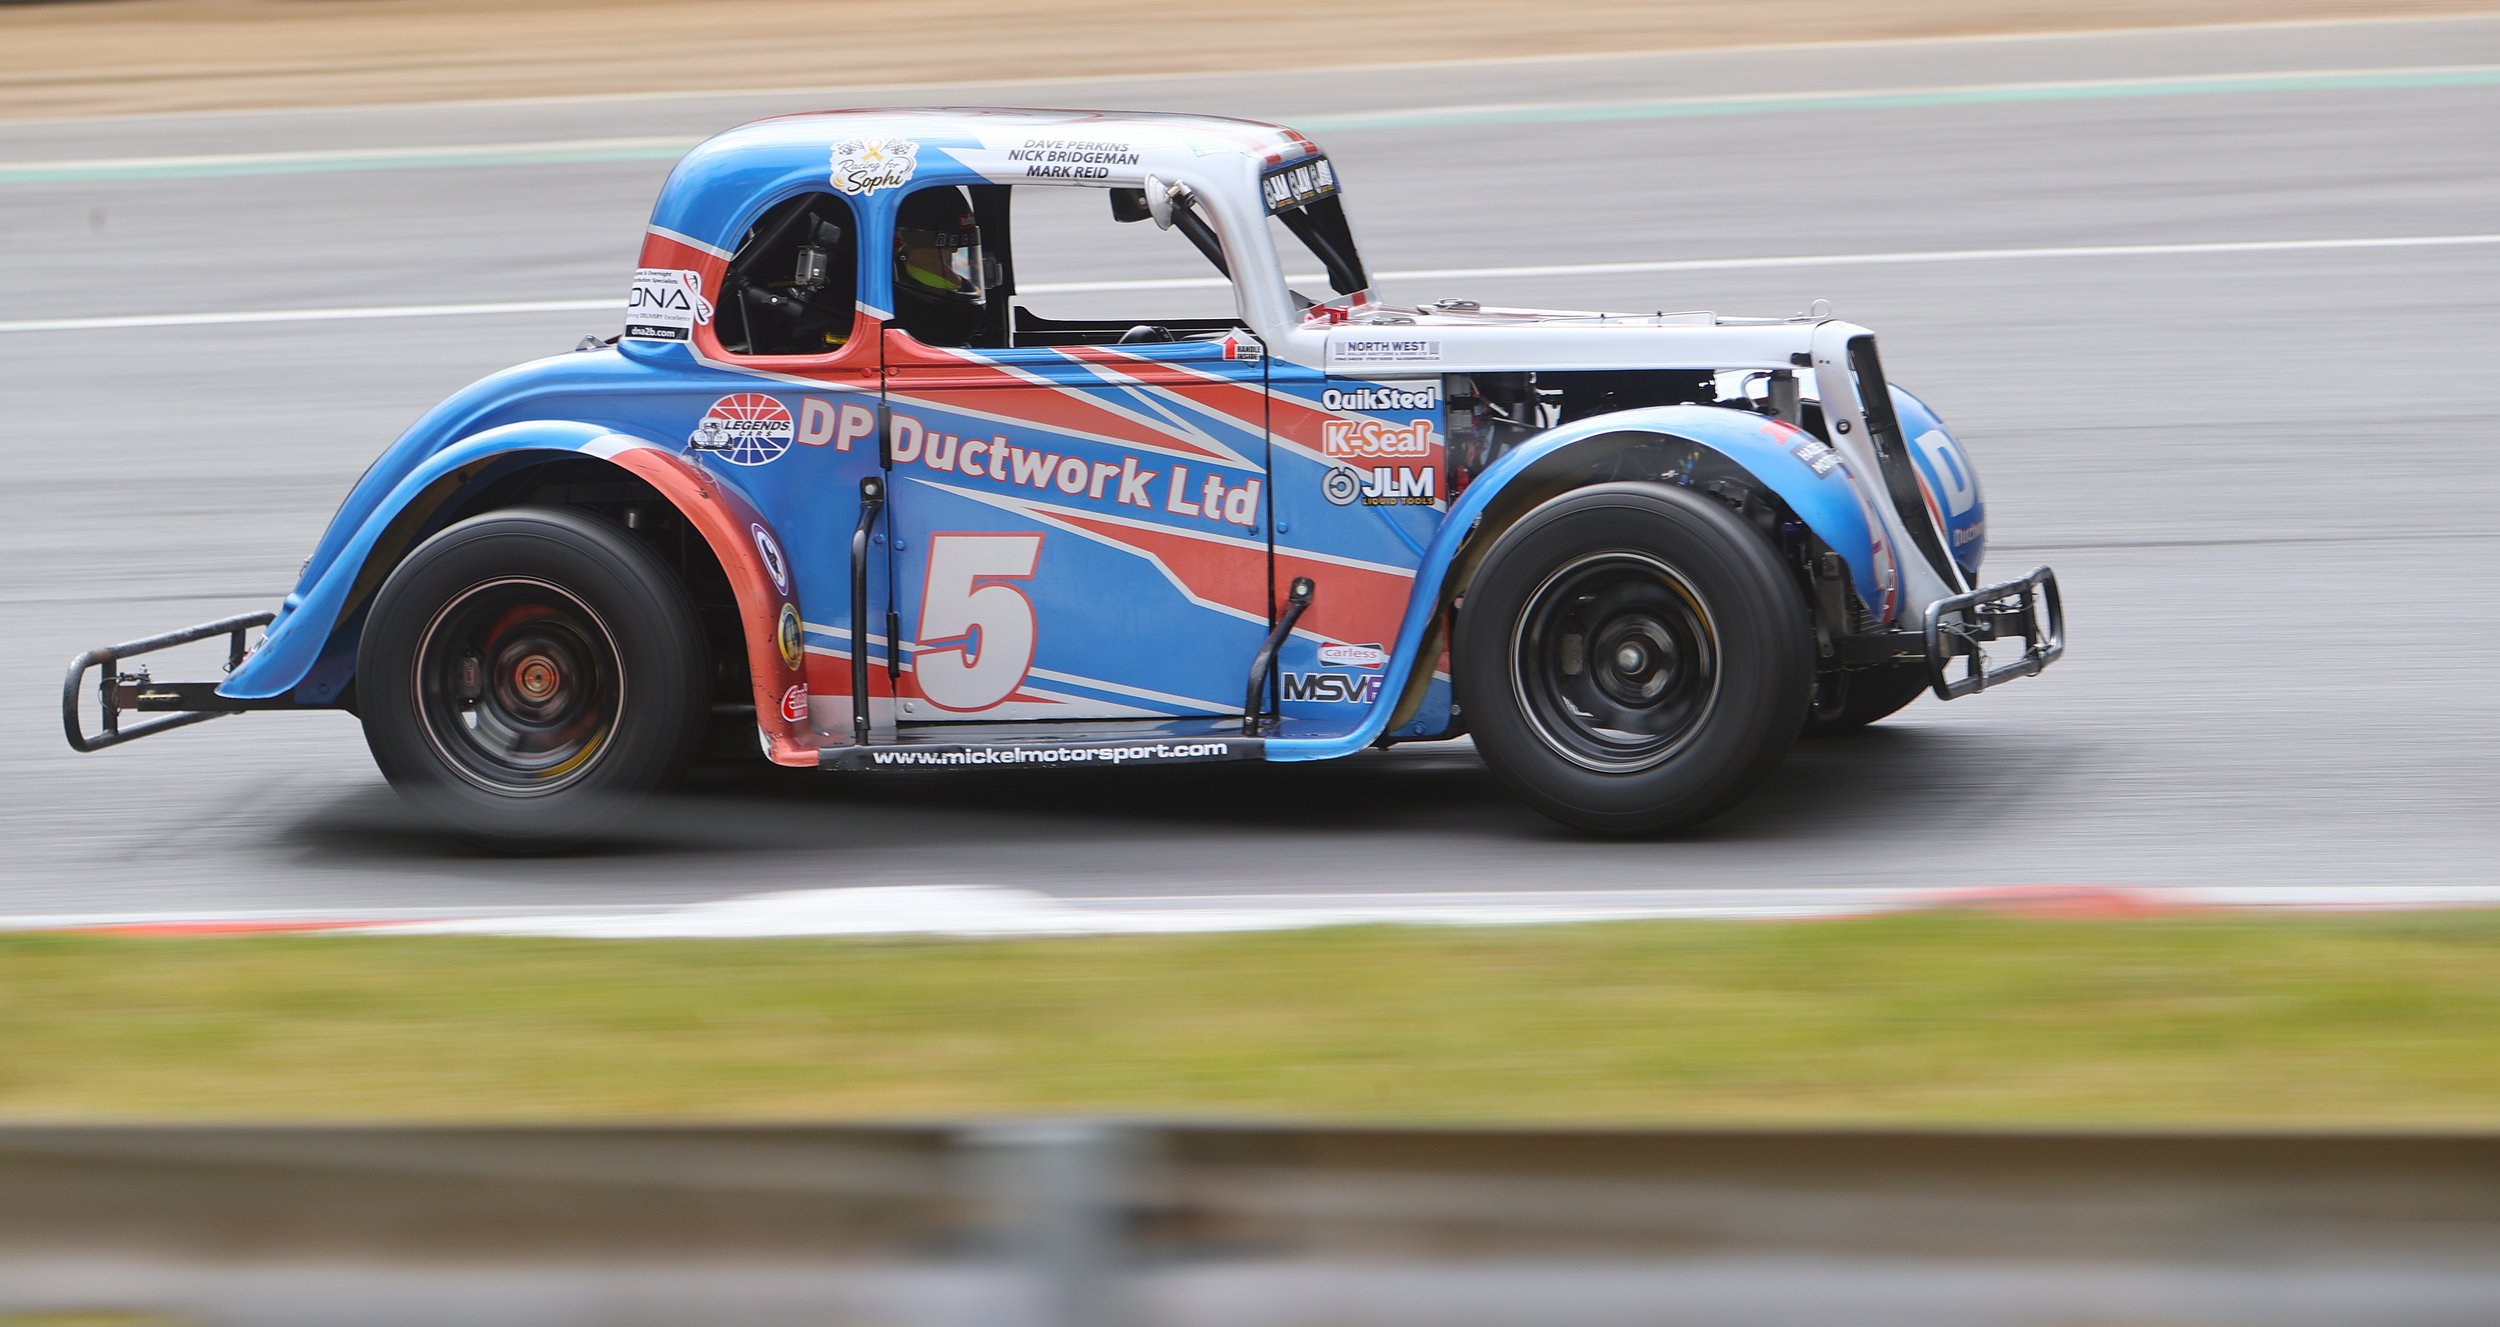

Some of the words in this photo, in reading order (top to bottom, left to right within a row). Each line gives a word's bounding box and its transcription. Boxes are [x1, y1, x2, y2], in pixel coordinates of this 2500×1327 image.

[1024, 140, 1065, 149] DAVE
[1067, 141, 1130, 152] PERKINS
[838, 159, 880, 172] Racing
[883, 158, 900, 171] for
[1008, 150, 1046, 161] NICK
[1047, 151, 1140, 165] BRIDGEMAN
[847, 169, 904, 194] Sophi
[1026, 165, 1072, 178] MARK
[1074, 166, 1109, 179] REID
[629, 287, 691, 310] DNA
[631, 326, 676, 338] dna2b.com
[1348, 342, 1390, 352] NORTH
[1392, 342, 1427, 352] WEST
[1321, 387, 1436, 411] QuikSteel
[724, 421, 791, 432] LEGENDS
[1325, 421, 1430, 456] K-Seal
[797, 397, 875, 452] DP
[890, 413, 1157, 509] Ductwork
[1166, 464, 1260, 527] Ltd
[1360, 466, 1436, 498] JLM
[1914, 429, 1976, 518] D
[1362, 498, 1397, 506] LIQUID
[1401, 498, 1436, 506] TOOLS
[912, 531, 1046, 713] 5
[1324, 648, 1378, 659] carless
[873, 741, 1228, 764] www.mickelmotorsport.com
